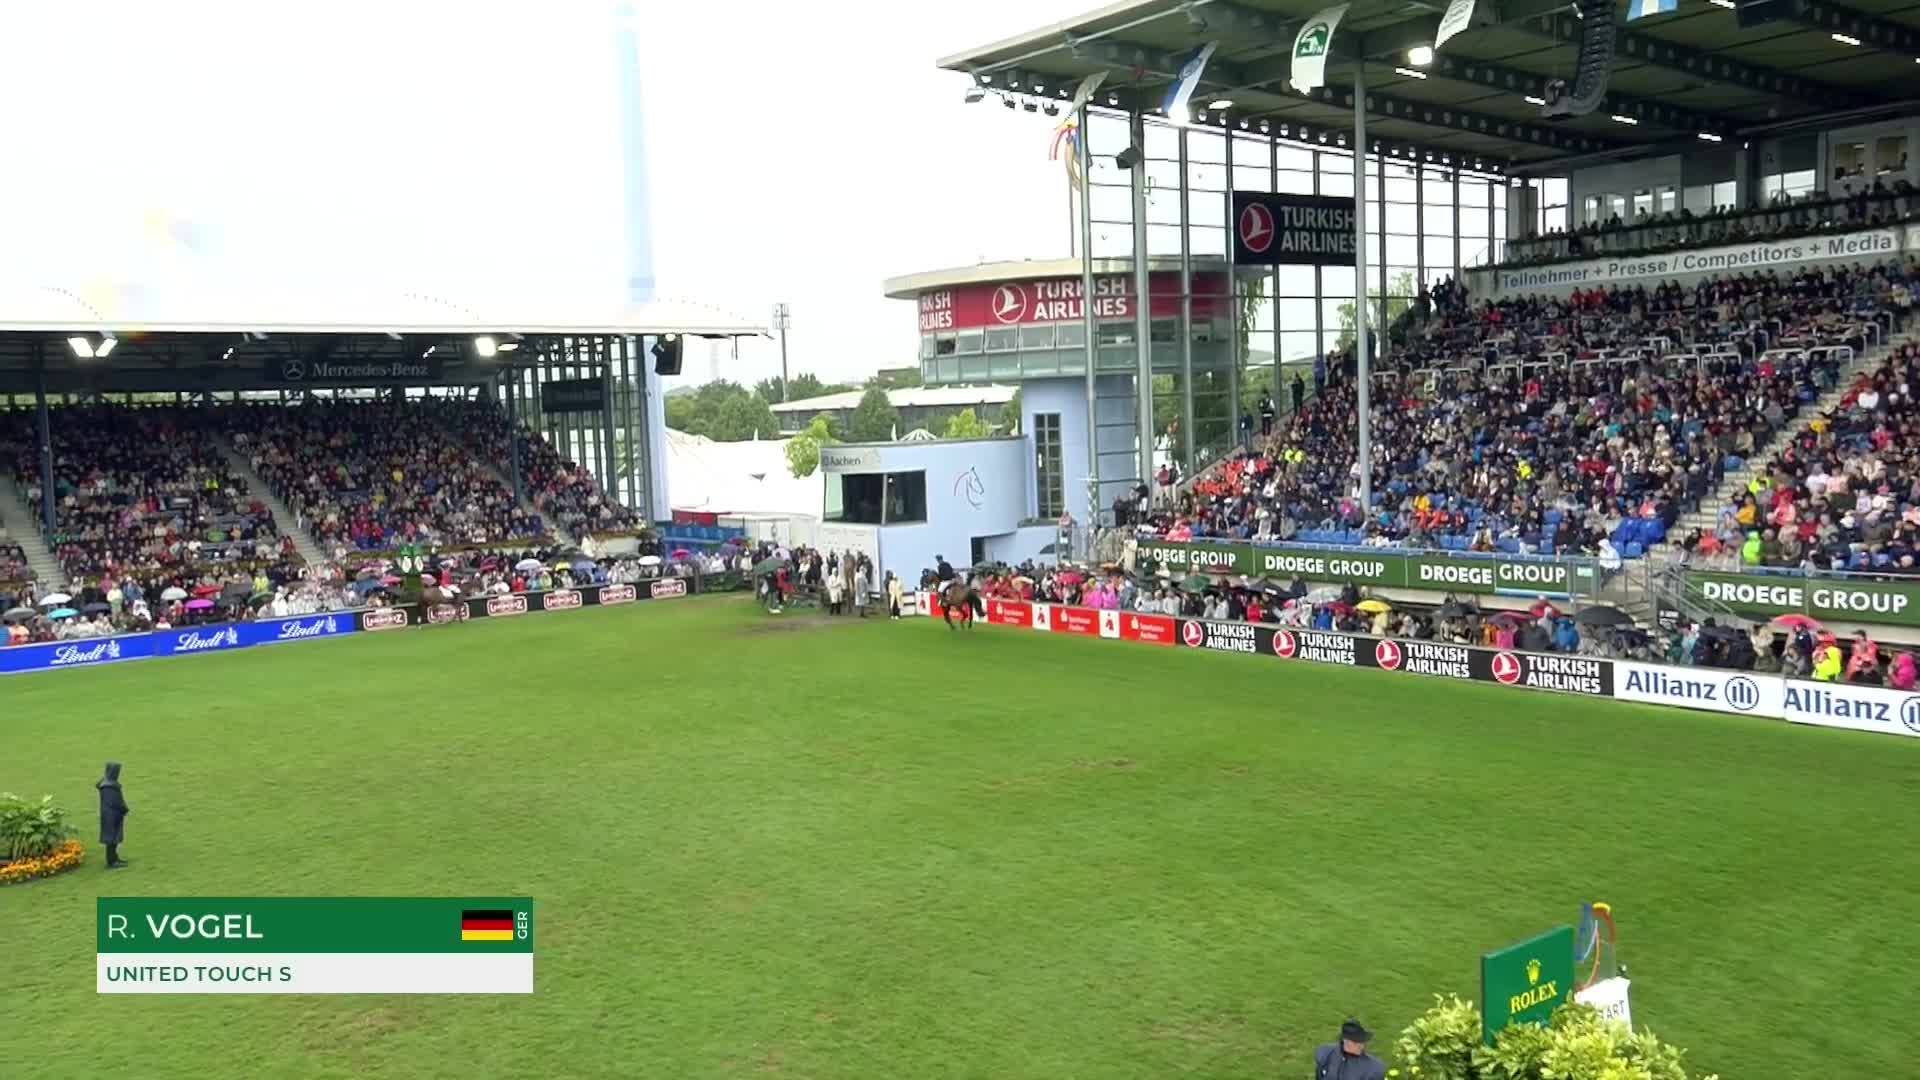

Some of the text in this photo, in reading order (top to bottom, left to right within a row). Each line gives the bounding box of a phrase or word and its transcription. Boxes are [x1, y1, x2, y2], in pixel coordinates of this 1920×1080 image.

[1281, 206, 1356, 230] TURKISH
[1281, 231, 1356, 253] AIRLINES
[1609, 259, 1667, 276] Presse
[1683, 245, 1803, 270] Competitors
[1828, 236, 1892, 254] Media
[1265, 555, 1384, 577] DROEGE GROUP
[1420, 564, 1566, 584] DROEGE GROUP
[1703, 582, 1908, 613] DROEGE GROUP
[278, 619, 325, 638] Lindt
[1206, 622, 1255, 639] TURKISH
[174, 630, 225, 651] Lindt
[1206, 635, 1256, 653] AIRLINES
[1299, 632, 1354, 650] TURKISH
[50, 644, 106, 665] Lindt
[1299, 648, 1356, 665] AIRLINES
[1406, 643, 1468, 663] TURKISH
[1405, 658, 1470, 678] AIRLINES
[1526, 656, 1600, 677] TURKISH
[1526, 672, 1601, 694] AIRLINES
[1625, 670, 1717, 700] Allianz
[1784, 687, 1891, 721] Allianz
[1510, 981, 1558, 1014] ROLEX
